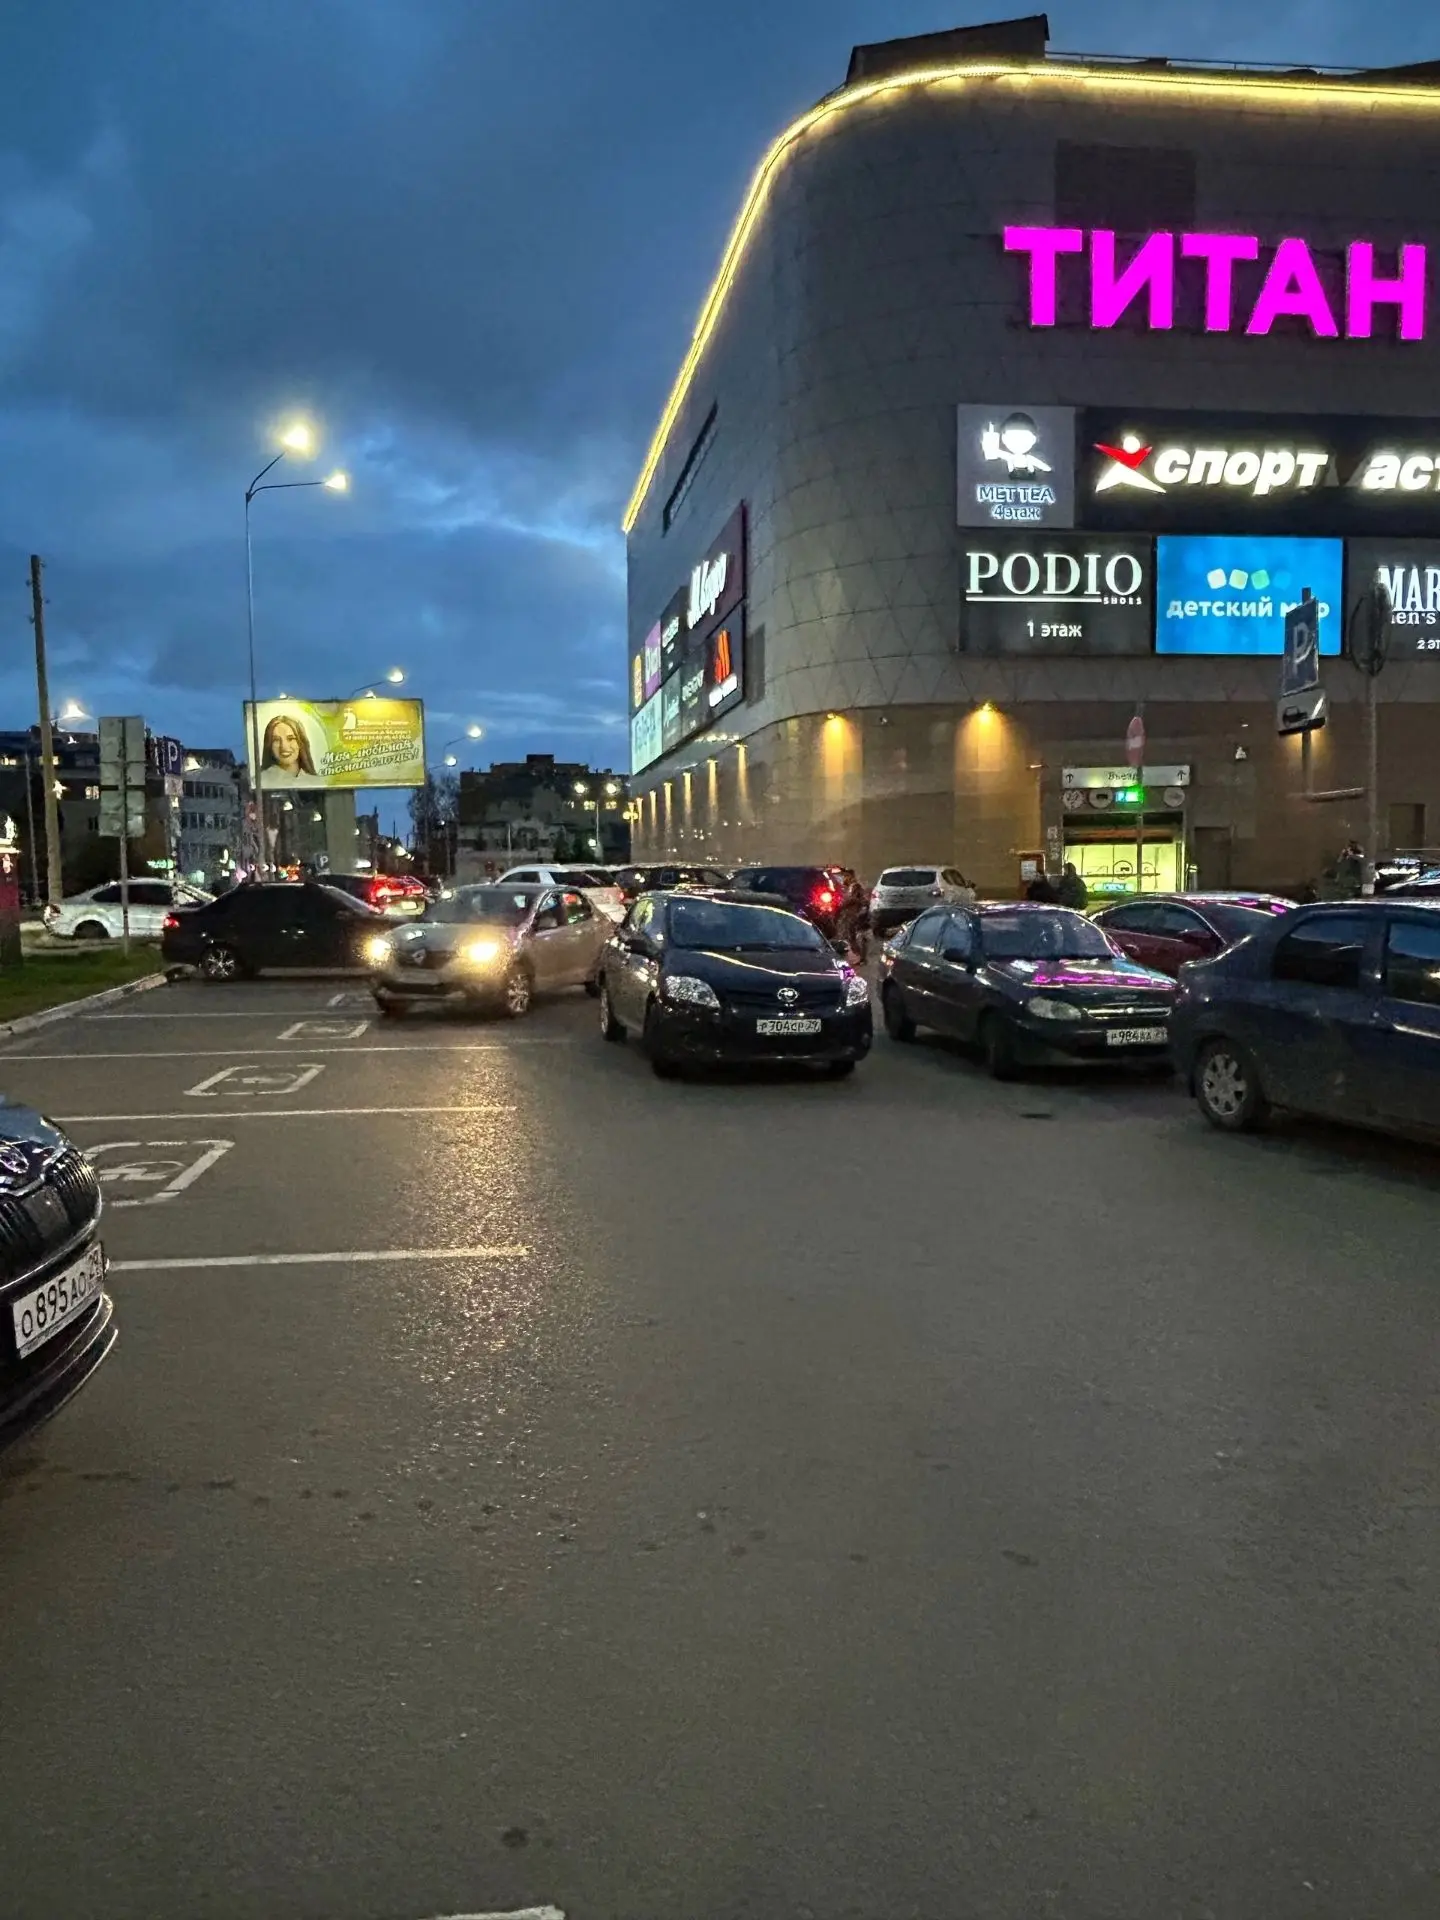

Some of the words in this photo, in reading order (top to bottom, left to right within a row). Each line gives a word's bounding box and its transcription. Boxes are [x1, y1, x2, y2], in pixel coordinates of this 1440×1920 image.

[1003, 226, 1426, 340] ТИТАН
[966, 553, 1143, 596] PODIO
[1103, 597, 1142, 608] SHOES
[1167, 597, 1273, 619] детский
[1280, 602, 1330, 624] мр
[1026, 620, 1034, 637] 1
[1041, 624, 1083, 638] этаж
[1417, 640, 1426, 650] 2
[167, 741, 178, 770] P
[321, 752, 350, 766] Моя
[352, 740, 416, 760] любимая
